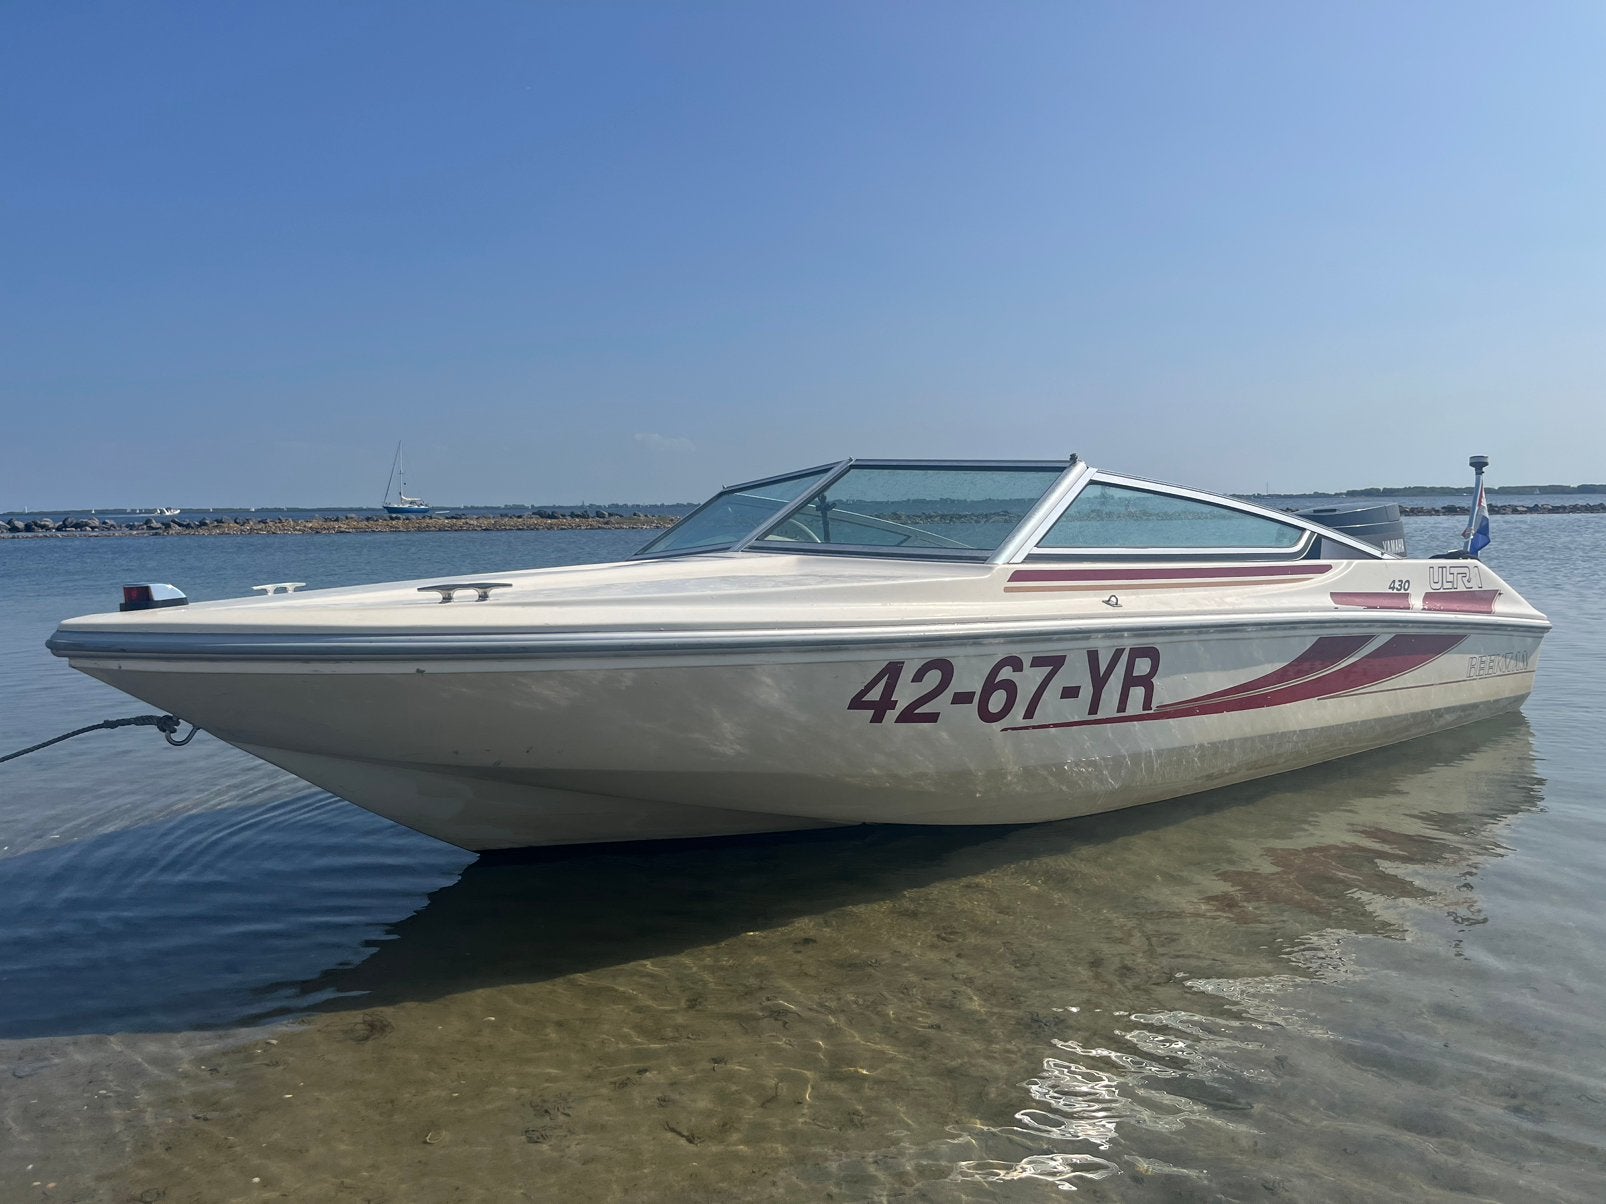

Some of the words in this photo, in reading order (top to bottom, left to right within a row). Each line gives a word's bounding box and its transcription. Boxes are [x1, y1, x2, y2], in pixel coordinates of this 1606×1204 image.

[1382, 538, 1405, 553] YAMAHA
[1388, 580, 1410, 592] 430
[847, 646, 1161, 724] 42-67-YR
